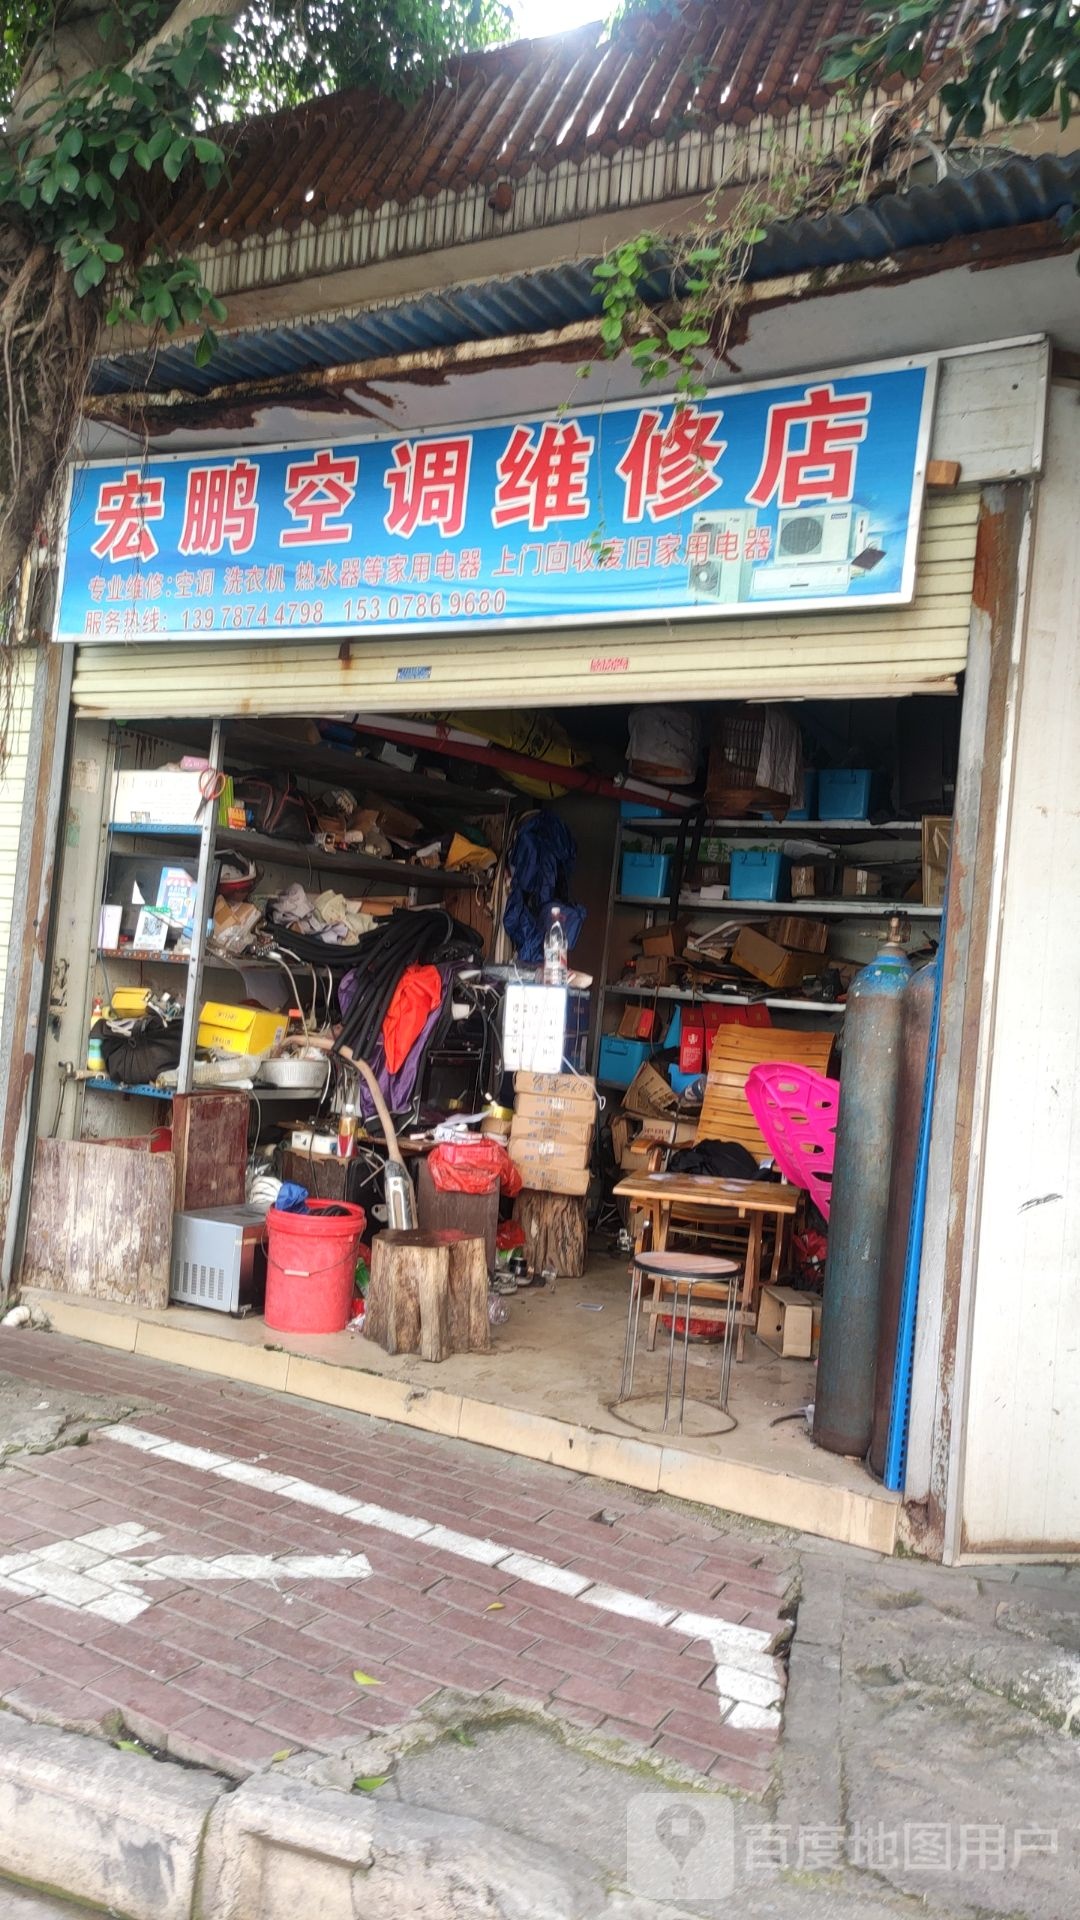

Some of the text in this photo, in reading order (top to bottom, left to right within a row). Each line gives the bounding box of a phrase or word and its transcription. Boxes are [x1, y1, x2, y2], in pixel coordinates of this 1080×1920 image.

[92, 384, 871, 563] 宏鹏空调维修店
[224, 564, 285, 594] 洗衣机
[295, 547, 481, 590] 热水器等家用电器
[492, 527, 771, 576] 上门回收废旧家用电器
